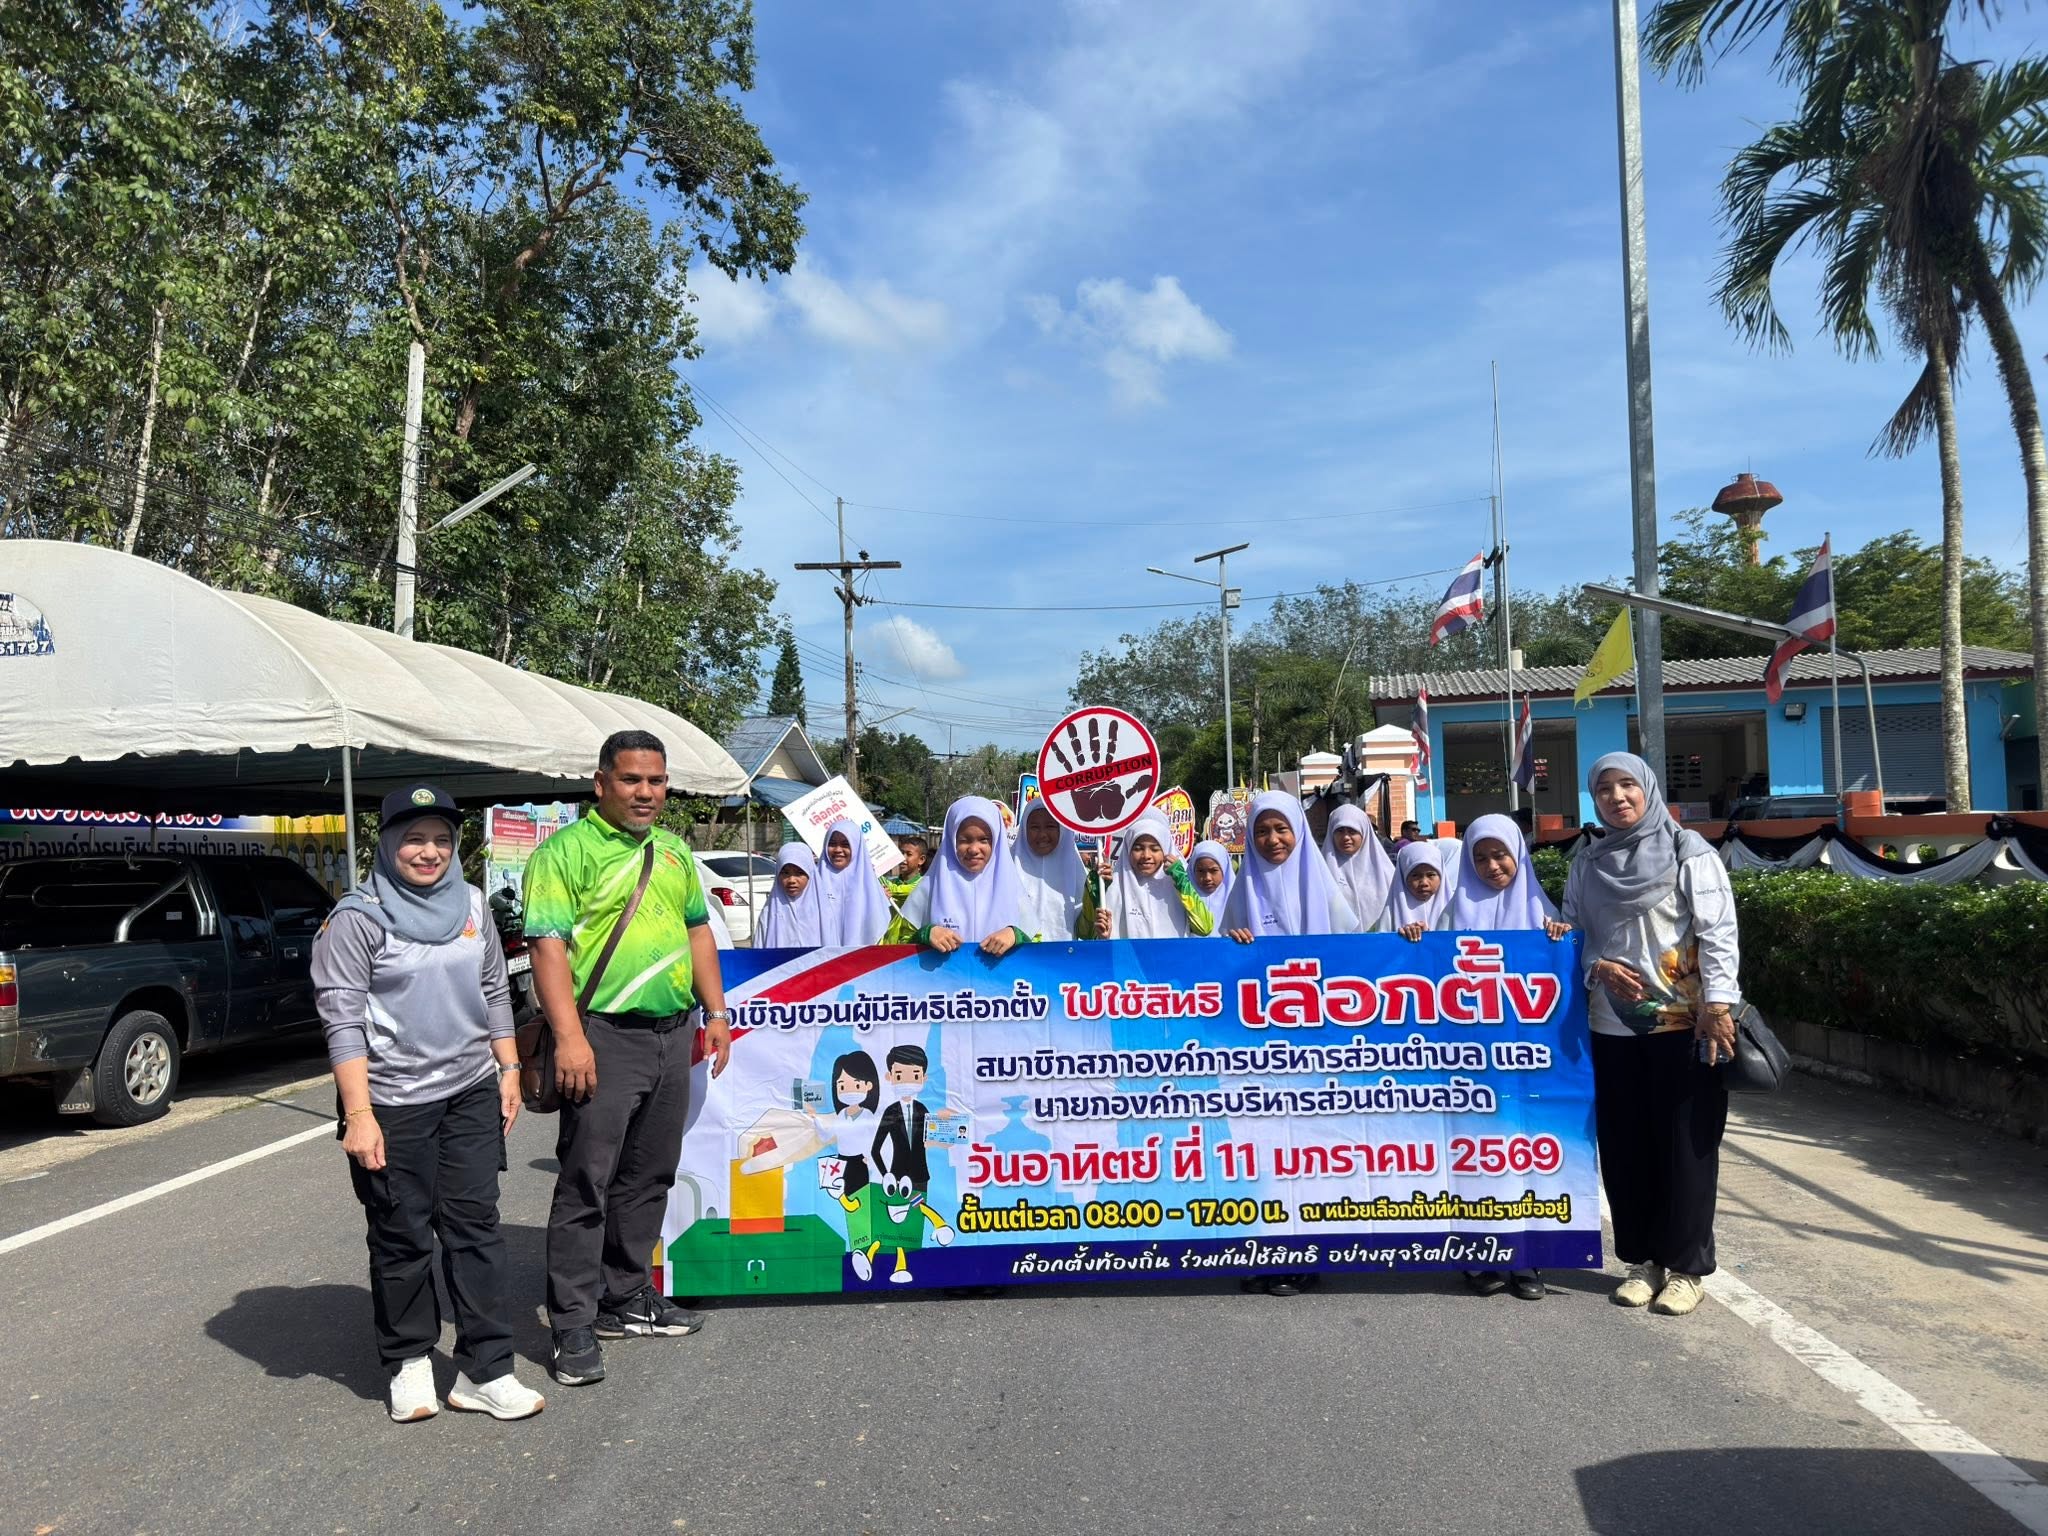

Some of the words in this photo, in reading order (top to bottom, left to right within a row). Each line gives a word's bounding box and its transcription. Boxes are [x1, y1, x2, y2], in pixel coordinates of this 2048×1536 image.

[1055, 757, 1152, 790] CORRUPTION
[809, 798, 848, 826] เลือกตั้ง
[860, 820, 873, 834] 69
[1064, 985, 1221, 1017] ไปใช้สิทธิ
[1240, 939, 1559, 1025] เลือกตั้ง
[977, 1037, 1484, 1080] สมาชิกสภาองค์การบริหารส่วนตำบล
[1495, 1043, 1552, 1068] และ
[1034, 1079, 1494, 1121] นายกองค์การบริหารส่วนตำบลวัด
[968, 1137, 1161, 1185] วันอาทิตย์
[1172, 1126, 1202, 1179] ที่
[1216, 1143, 1257, 1178] 11
[1273, 1143, 1436, 1176] มกราคม
[1450, 1136, 1561, 1174] 2569
[958, 1195, 1078, 1233] ตั้งแต่เวลา
[1085, 1202, 1163, 1229] 08.00
[1188, 1200, 1258, 1225] 17.00
[1262, 1201, 1288, 1222] น.
[1324, 1190, 1571, 1222] หน่วยเลือกตั้งที่ท่านมีรายชื่ออยู่
[1012, 1245, 1172, 1277] เลือกตั้งท้องถิ่น
[1180, 1240, 1318, 1270] ร่วมกันใช้สิทธิ
[1328, 1235, 1514, 1268] อย่างสุจริตโปร่งใส
